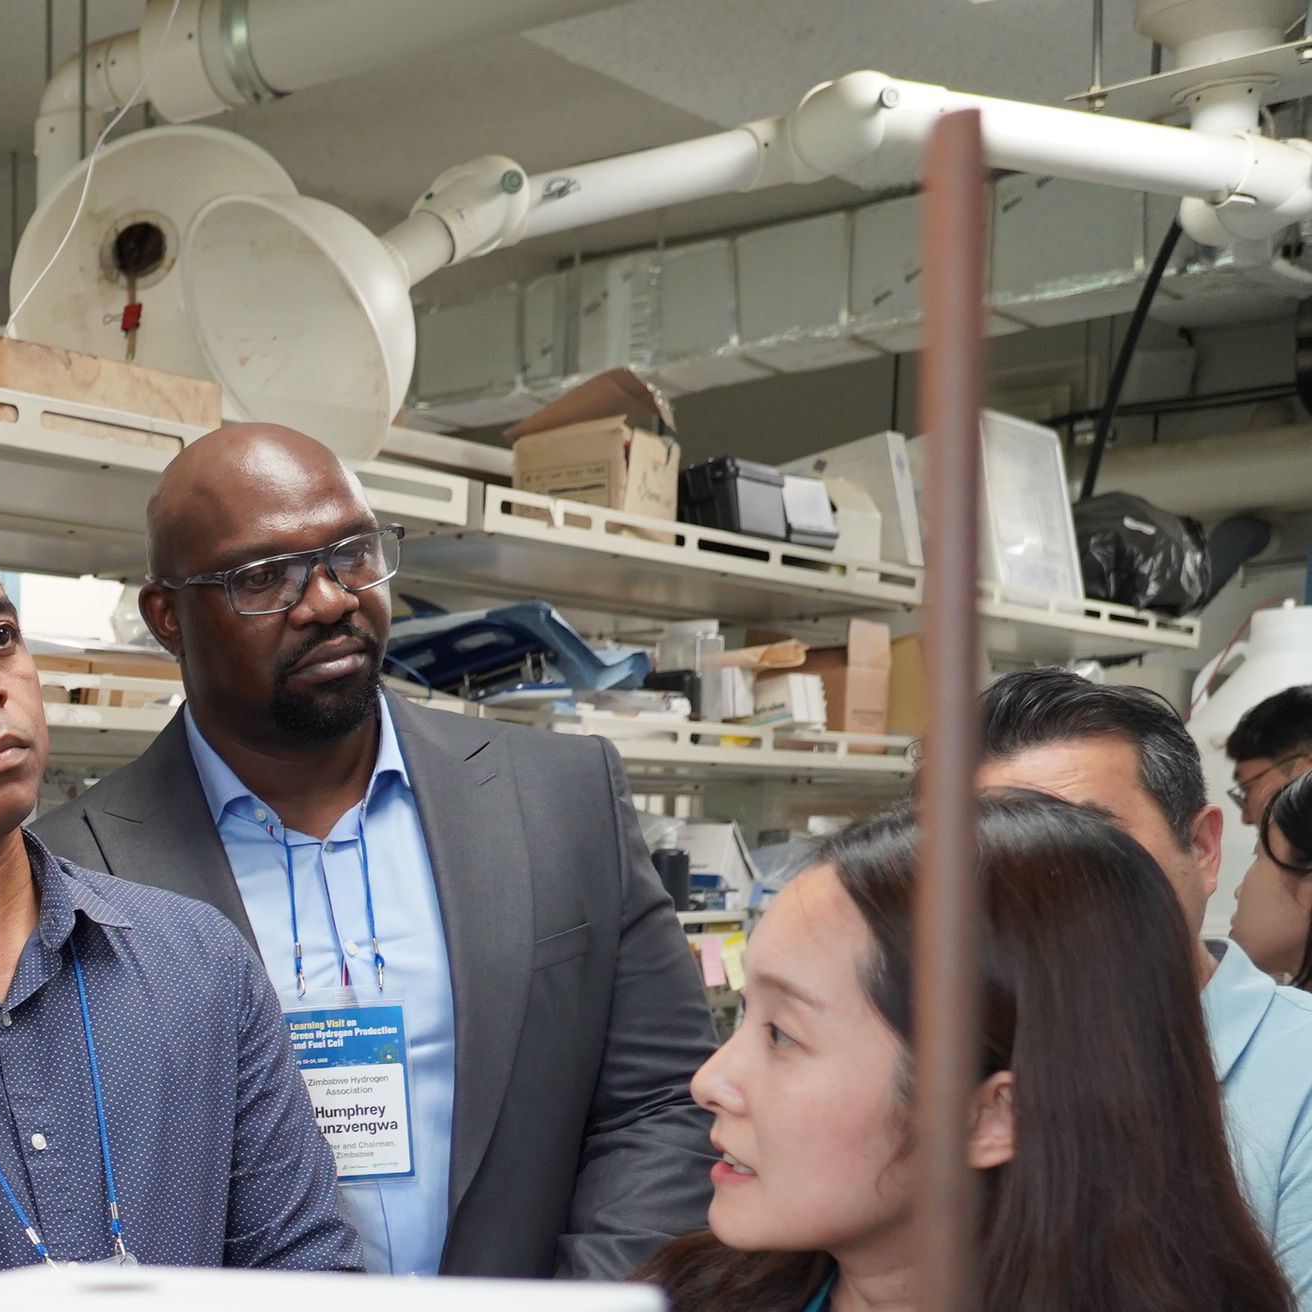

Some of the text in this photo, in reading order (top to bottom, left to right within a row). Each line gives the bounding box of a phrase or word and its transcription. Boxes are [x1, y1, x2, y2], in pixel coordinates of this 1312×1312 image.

[289, 1018, 357, 1031] Learning Visit on
[290, 1026, 398, 1041] Green Hydrogen Production
[308, 1040, 326, 1049] Fuel
[327, 1038, 344, 1048] Cell
[307, 1075, 389, 1087] Zimbabwe Hydrogen
[325, 1086, 373, 1096] Association
[315, 1104, 386, 1121] Humphrey
[318, 1120, 398, 1135] unzvengwa
[342, 1141, 357, 1149] and
[358, 1140, 397, 1149] Chairman,
[335, 1151, 375, 1160] Zimbabwe
